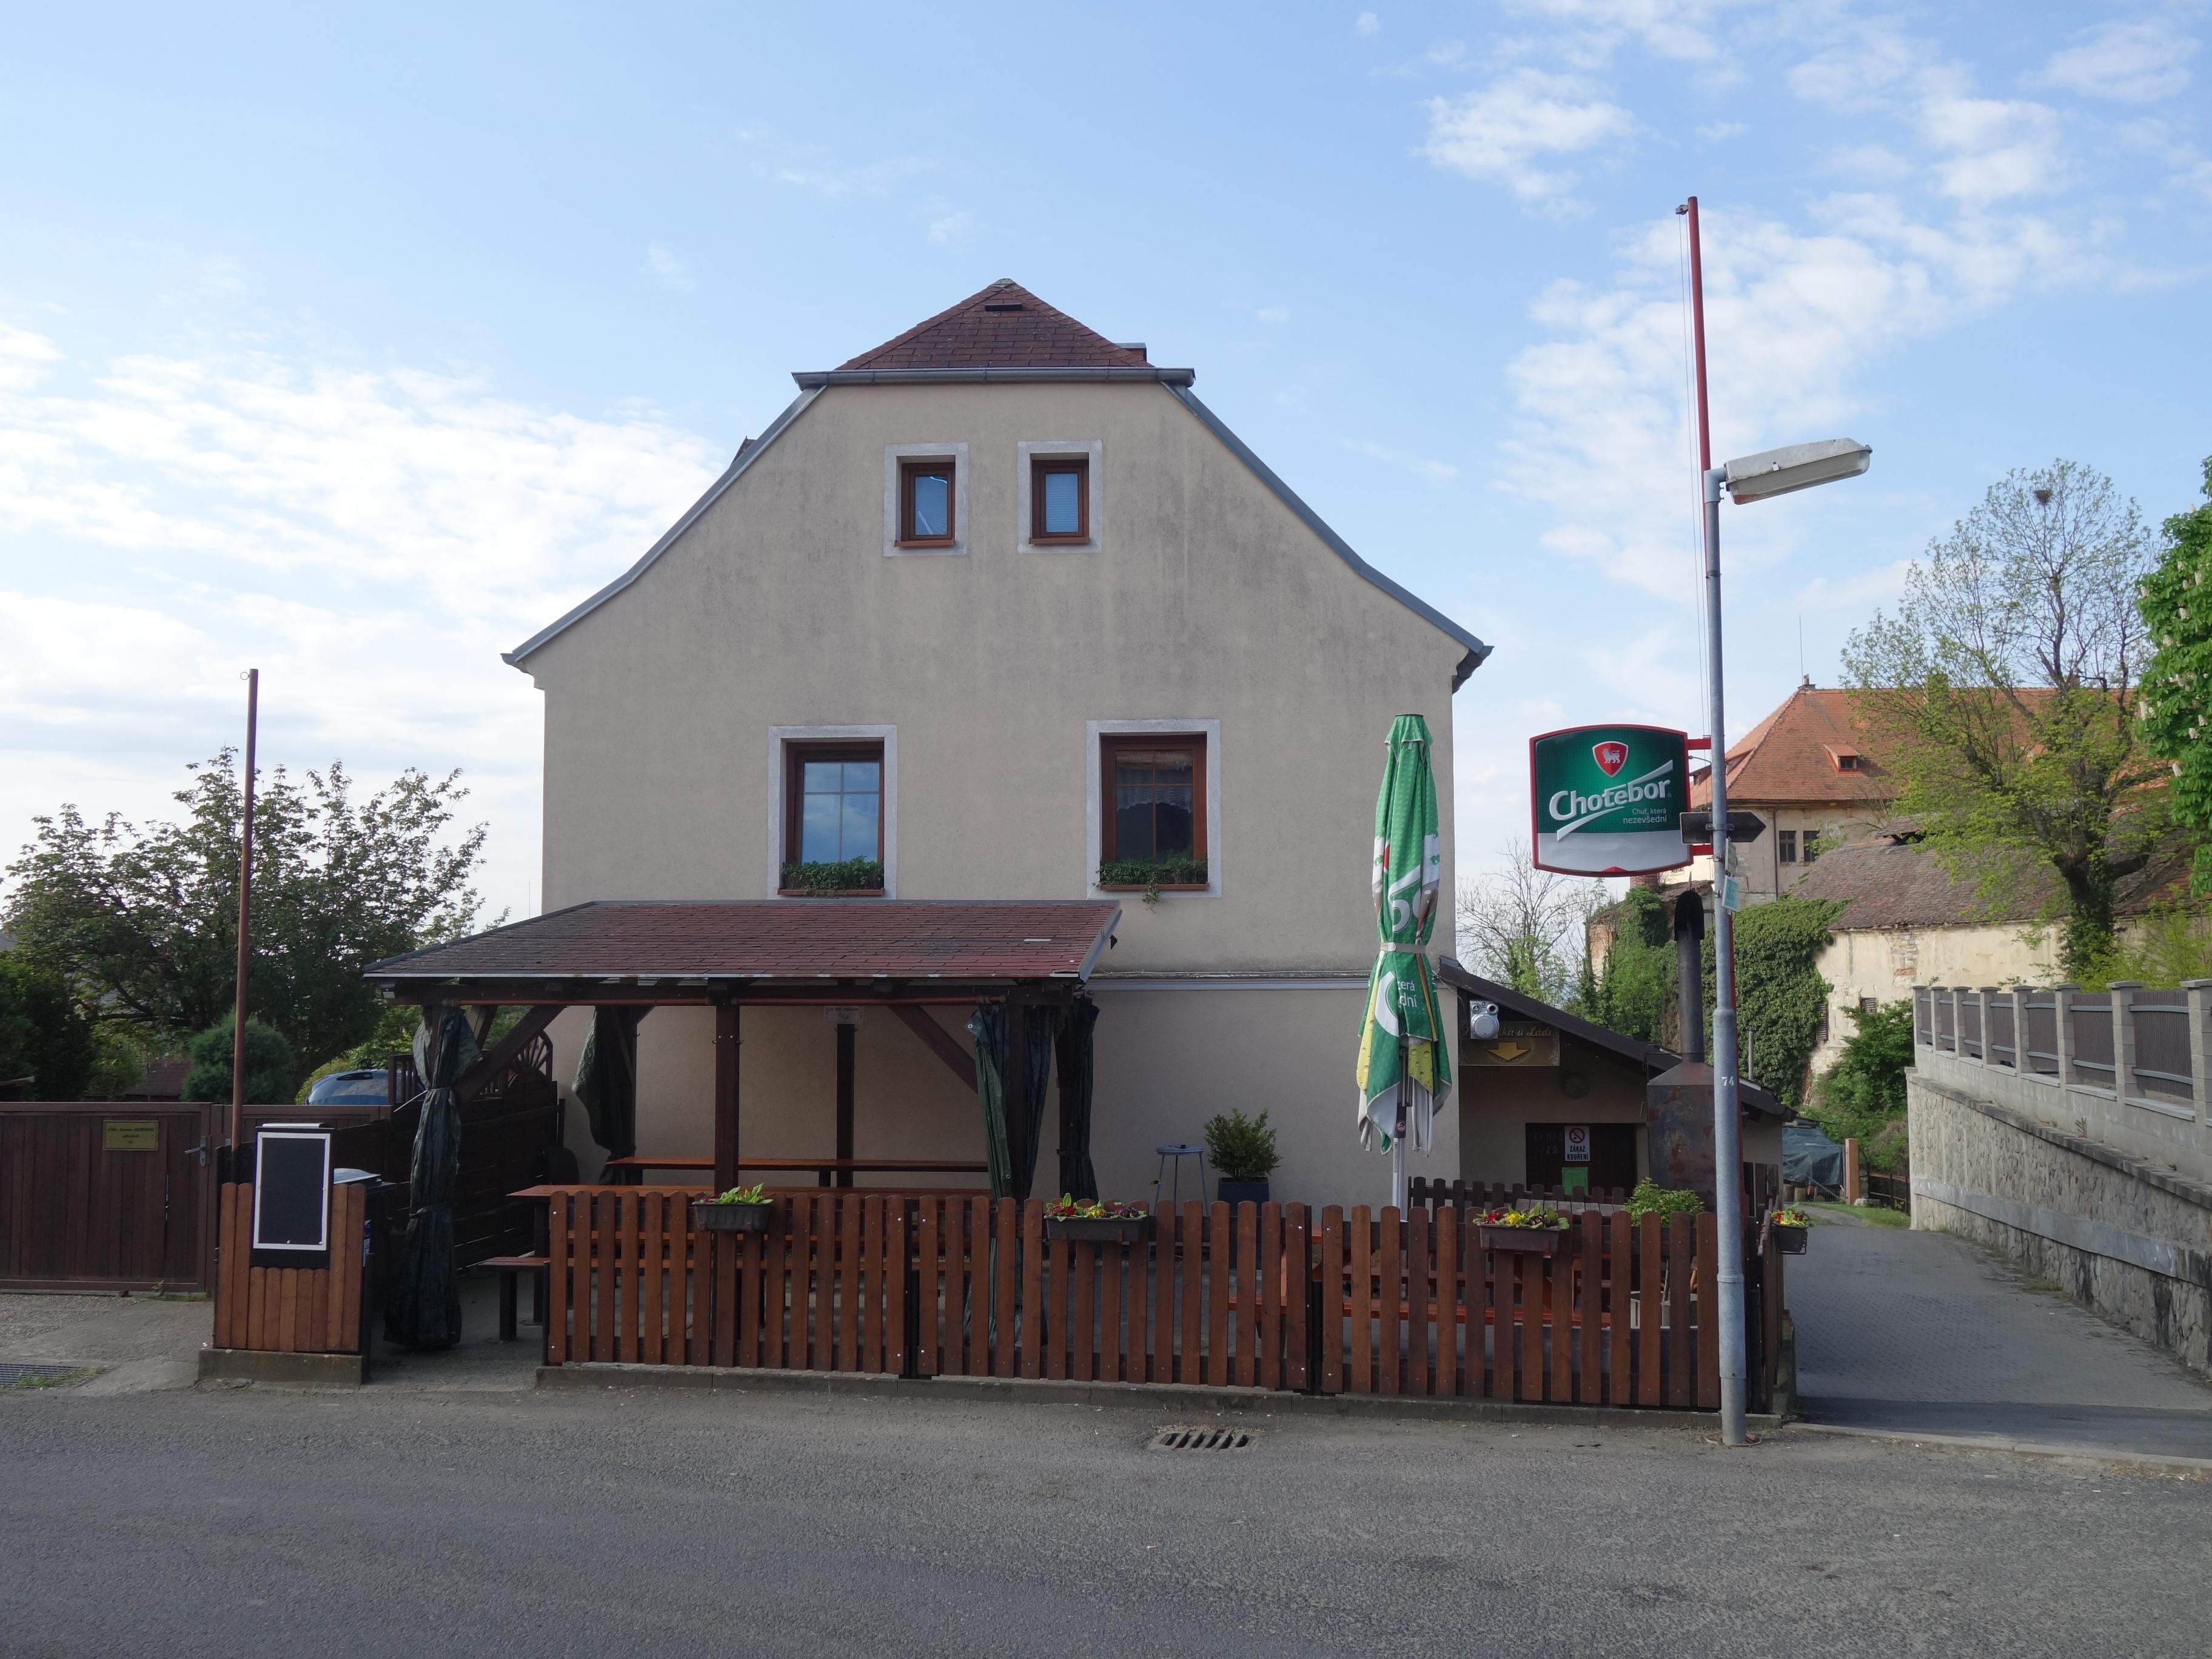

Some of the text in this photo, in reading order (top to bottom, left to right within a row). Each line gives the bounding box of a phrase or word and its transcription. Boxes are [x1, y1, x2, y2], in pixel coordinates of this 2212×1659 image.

[1623, 815, 1667, 824] nezevšední
[1721, 1076, 1734, 1086] 74
[1567, 1152, 1589, 1161] KOUŘENÍ
